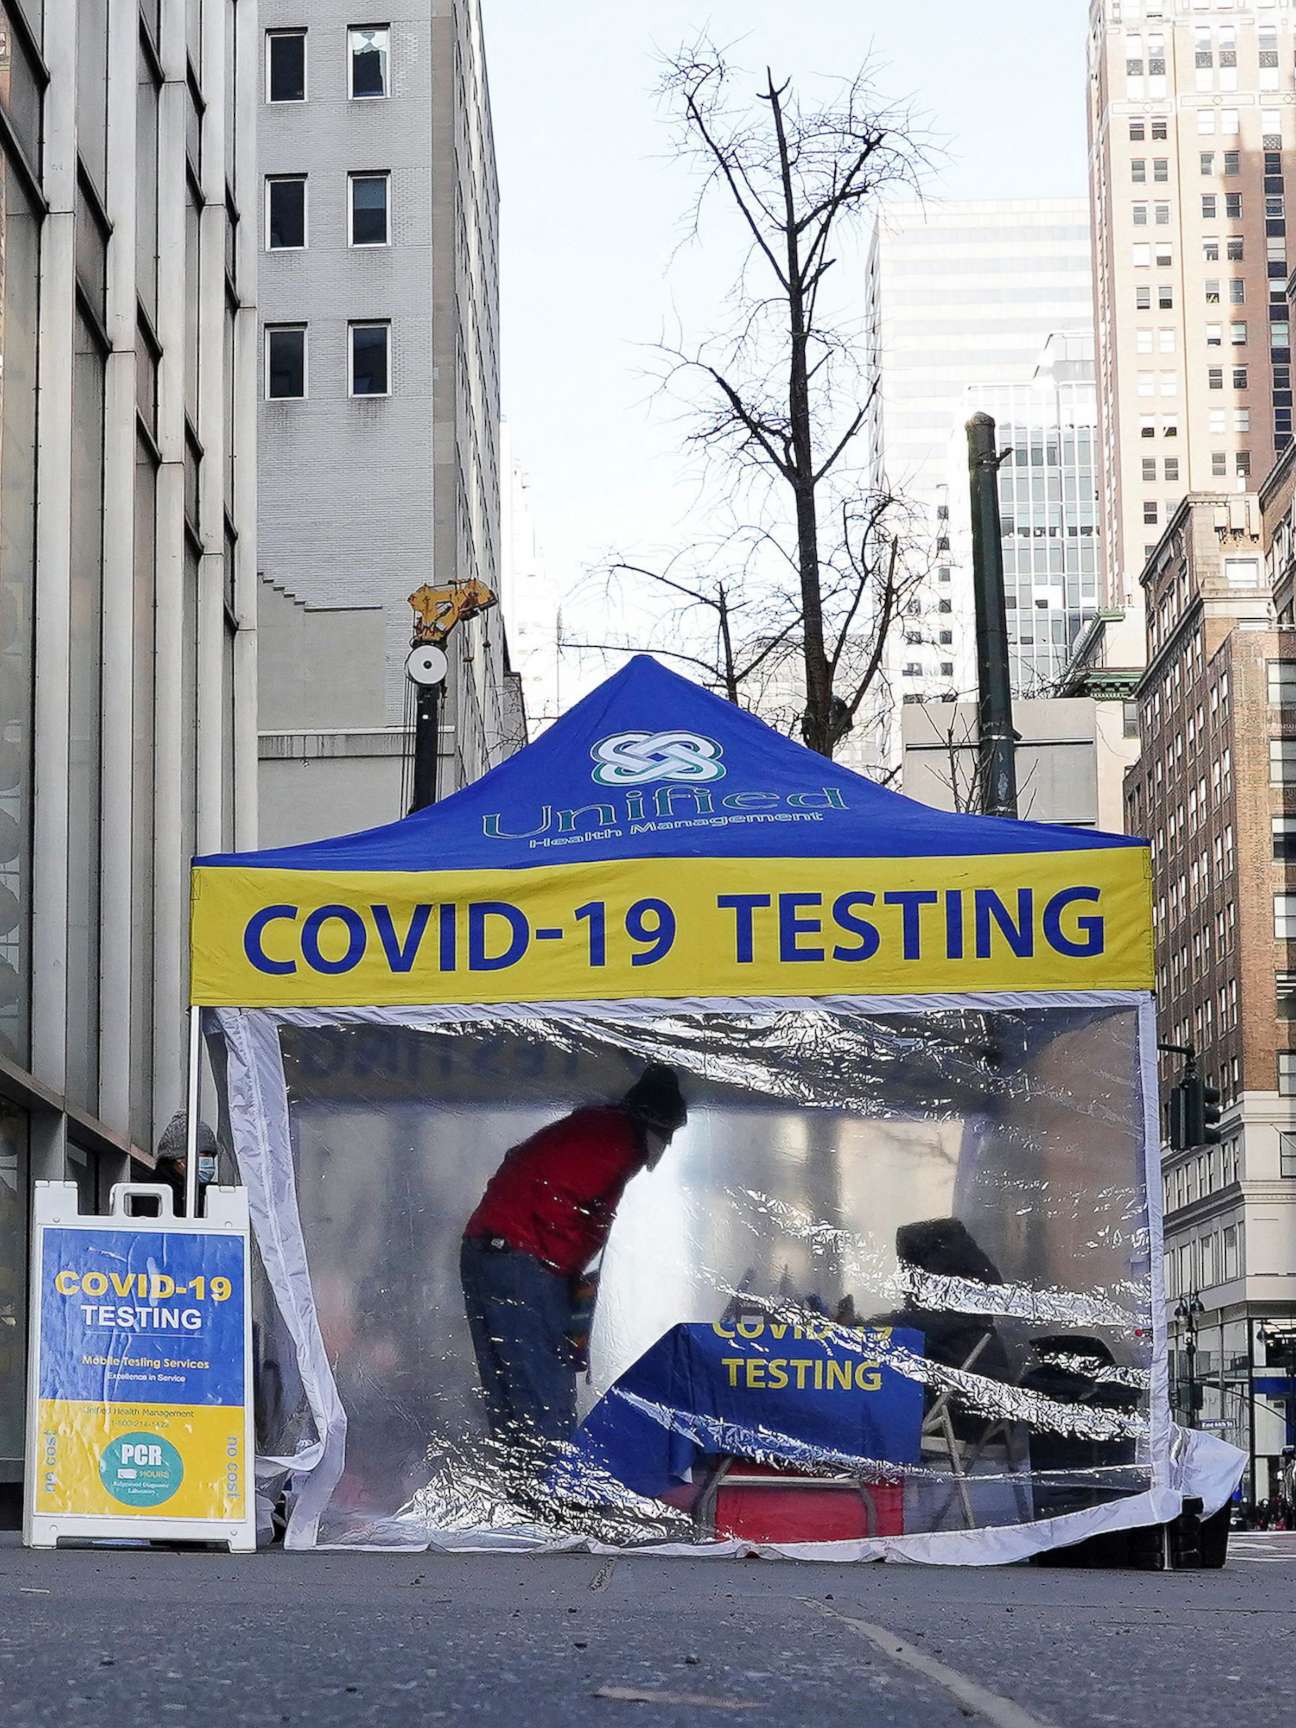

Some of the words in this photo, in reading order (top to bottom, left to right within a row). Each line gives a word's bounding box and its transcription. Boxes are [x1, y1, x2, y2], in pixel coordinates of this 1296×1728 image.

[482, 785, 850, 840] Unified
[529, 828, 623, 849] Health
[630, 810, 823, 835] Management
[243, 897, 677, 976] COVID-19
[717, 886, 1104, 963] TESTING
[54, 1270, 232, 1302] COVID-19
[80, 1304, 202, 1330] TESTING
[82, 1355, 120, 1366] Mobile
[122, 1356, 161, 1369] Testing
[164, 1358, 210, 1369] Services
[722, 1358, 882, 1391] TESTING
[149, 1373, 156, 1381] in
[157, 1373, 186, 1382] Service
[84, 1407, 111, 1416] nified
[142, 1408, 194, 1418] Management
[121, 1443, 162, 1466] PCR
[226, 1436, 238, 1457] no
[226, 1462, 240, 1498] cost
